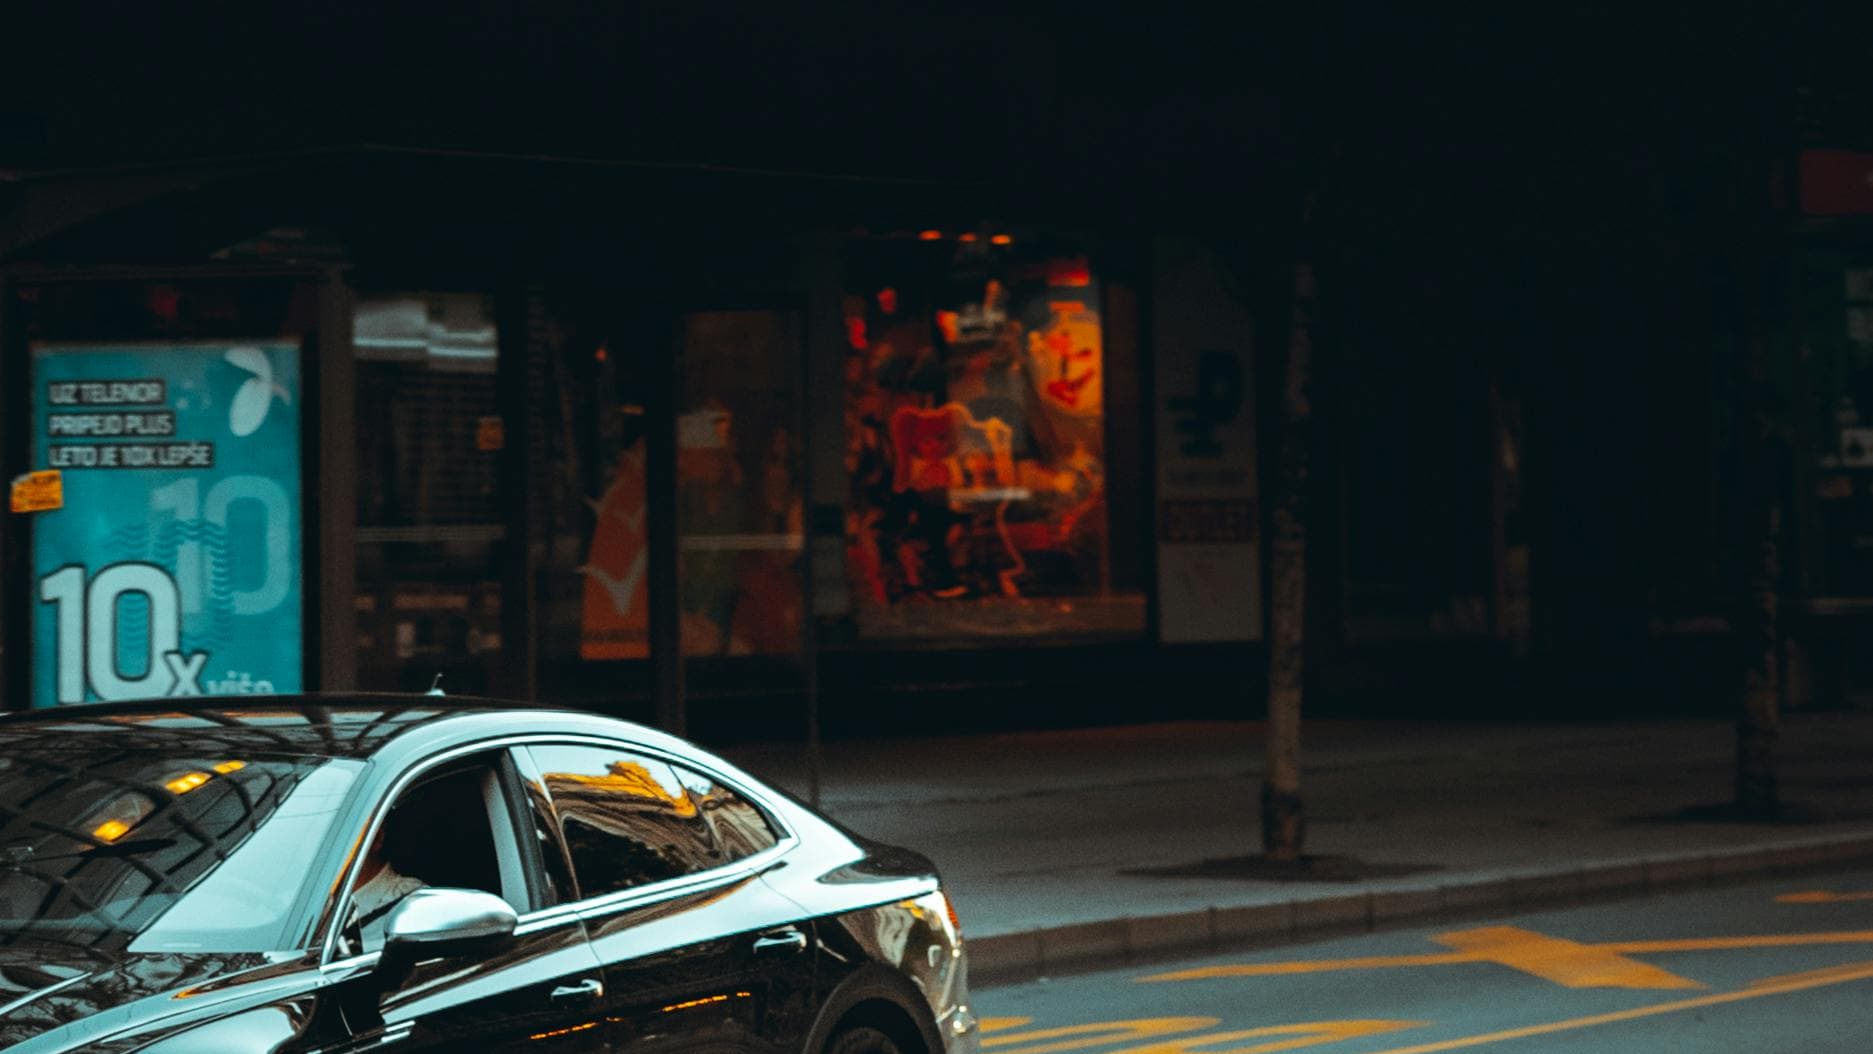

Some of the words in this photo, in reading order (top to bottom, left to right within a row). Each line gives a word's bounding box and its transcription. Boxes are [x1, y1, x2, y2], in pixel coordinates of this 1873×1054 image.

[81, 382, 162, 403] TELENOR
[125, 415, 173, 435] PLUS
[50, 446, 97, 466] LETO
